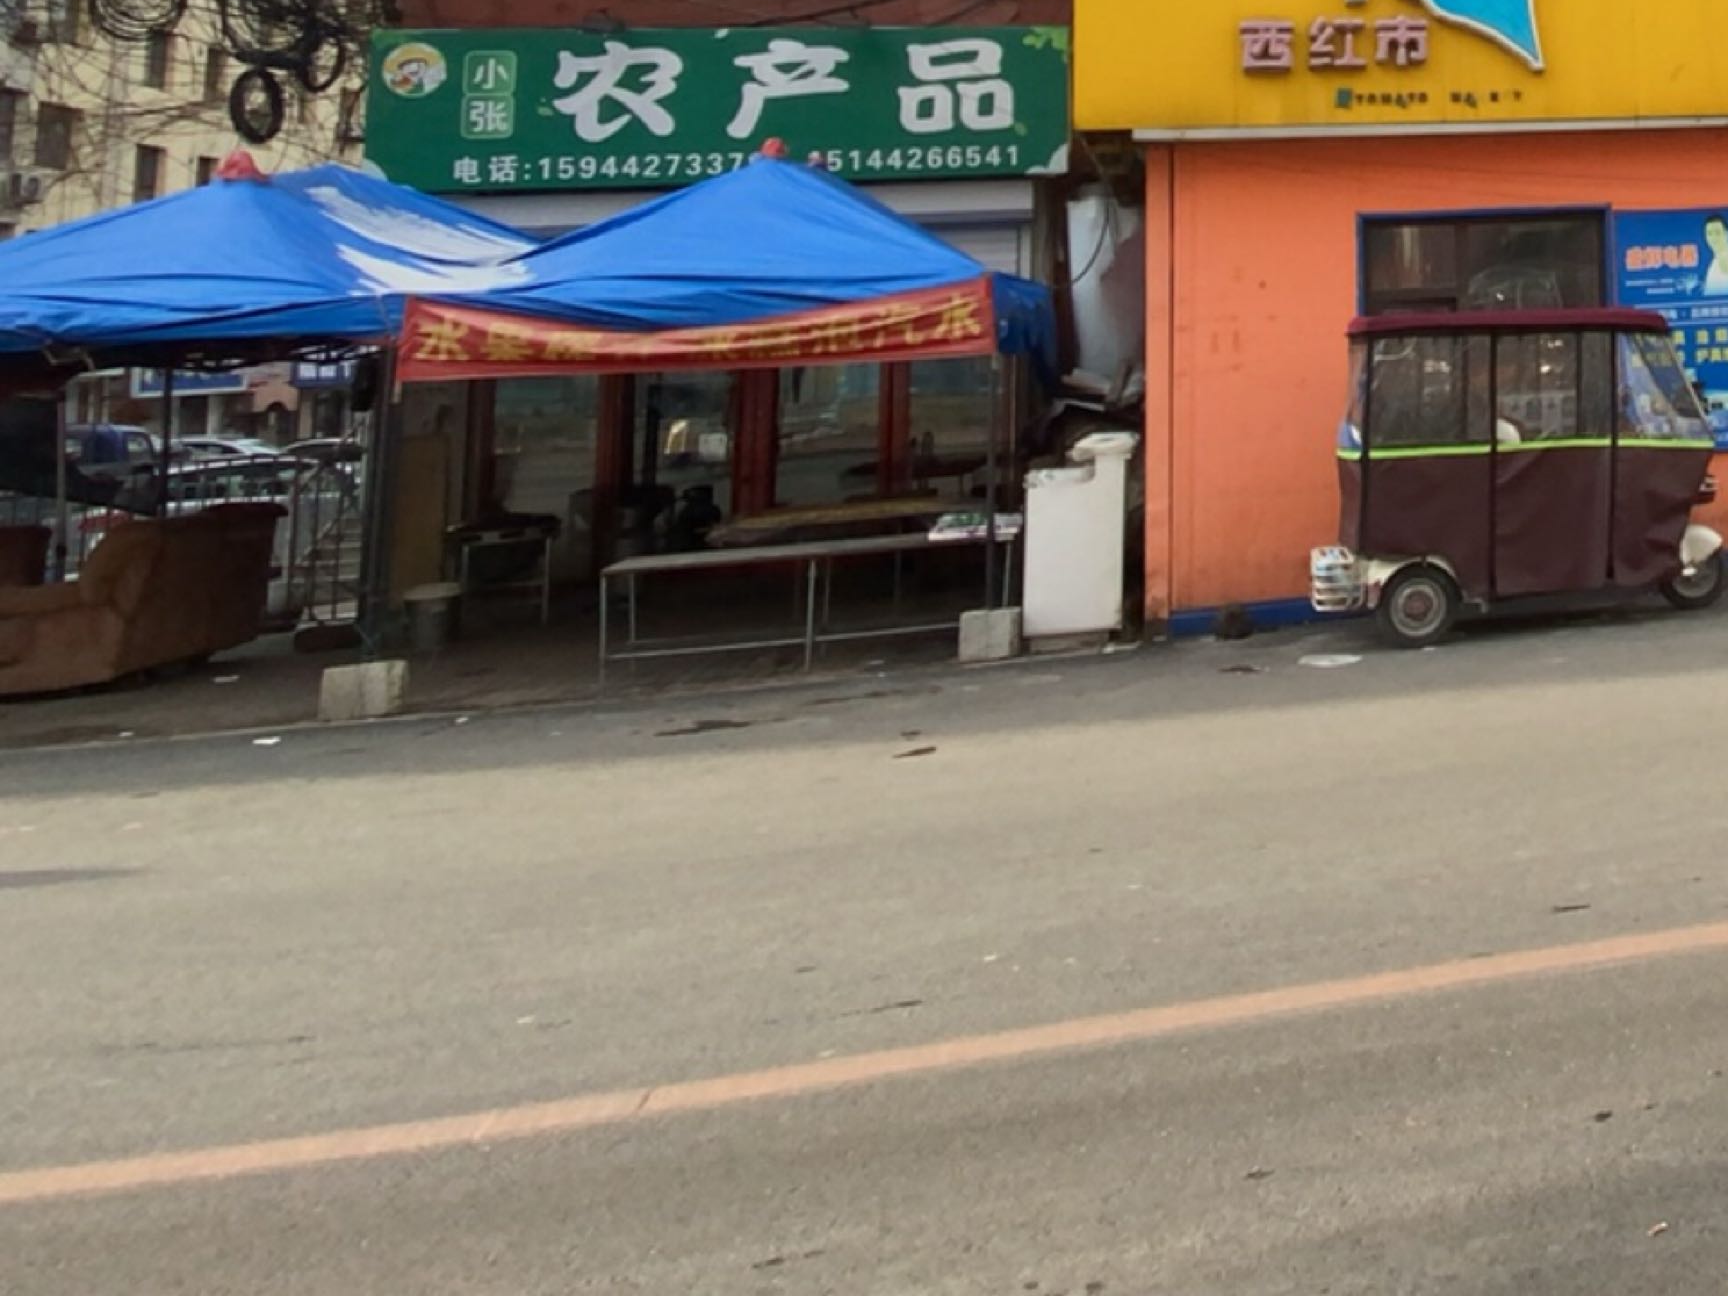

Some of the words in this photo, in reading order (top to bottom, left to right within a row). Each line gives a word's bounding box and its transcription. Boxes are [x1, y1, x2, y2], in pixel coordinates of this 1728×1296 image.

[1240, 16, 1429, 71] 西红市
[469, 57, 508, 133] 小张
[552, 39, 1014, 142] 农产品
[453, 151, 762, 184] 电话:1594427337
